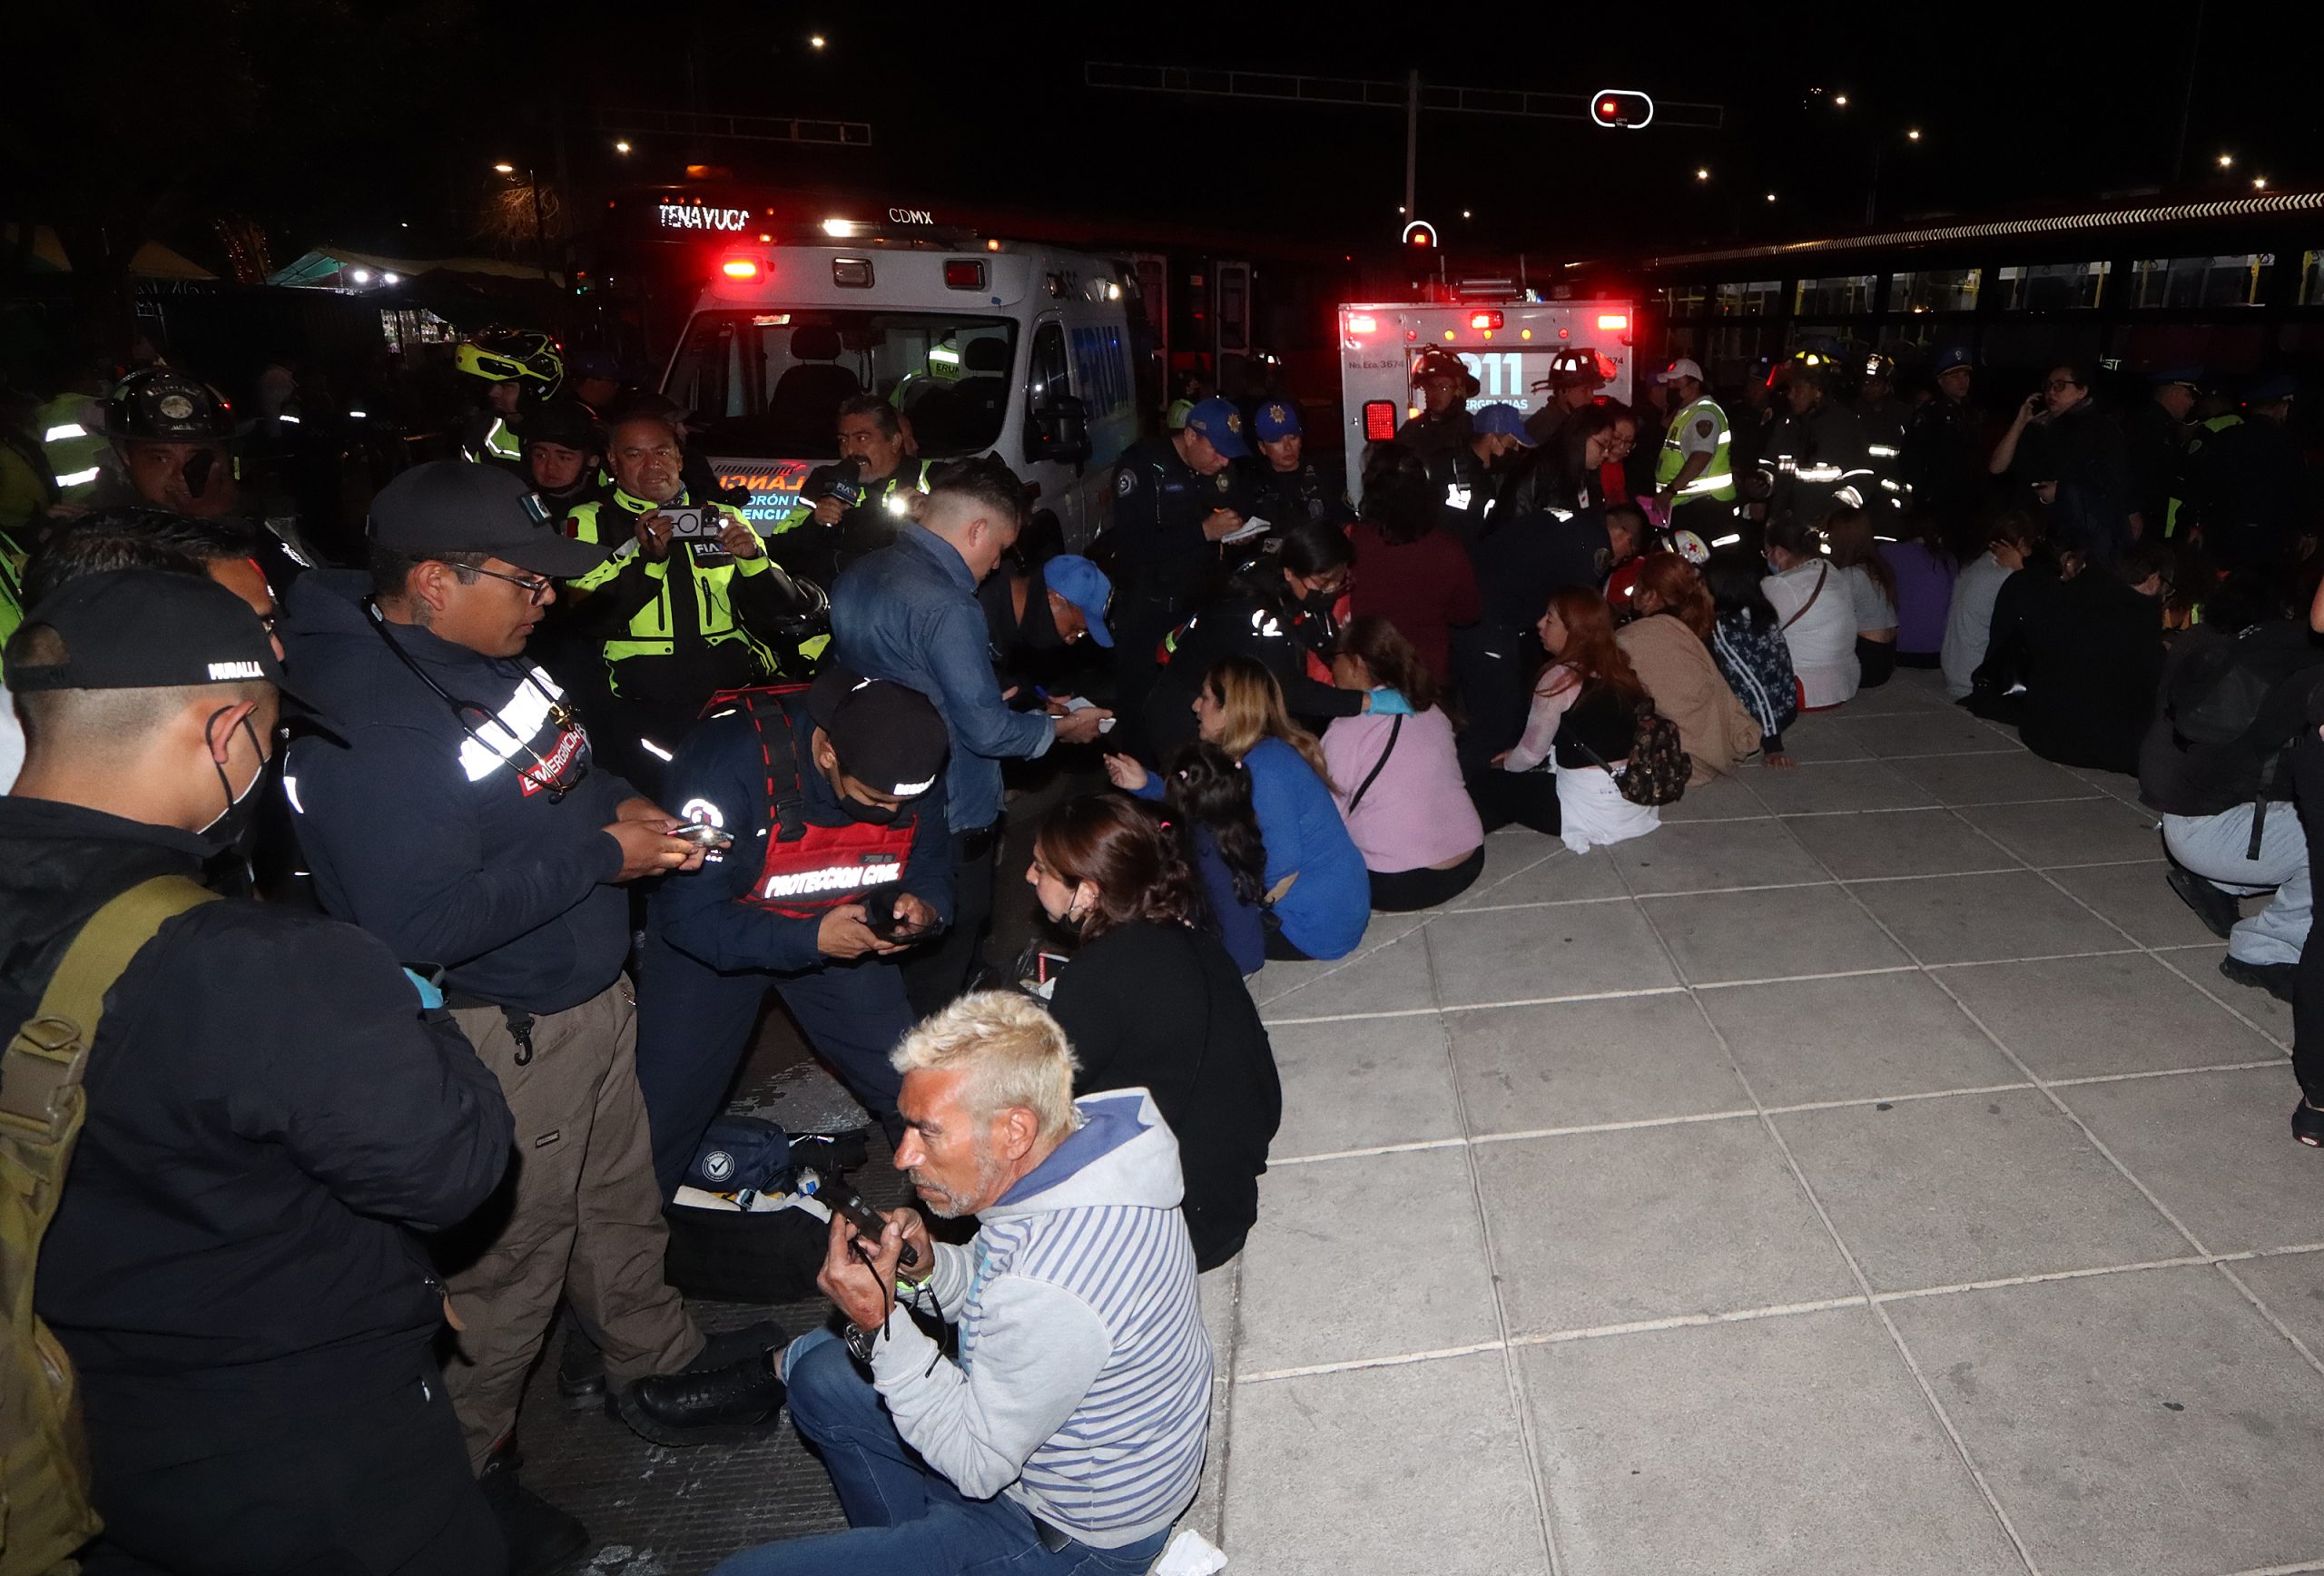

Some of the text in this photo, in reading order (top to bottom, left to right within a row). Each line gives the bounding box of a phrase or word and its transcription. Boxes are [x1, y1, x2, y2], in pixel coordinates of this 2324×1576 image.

[889, 207, 934, 225] CDMX
[1380, 360, 1405, 369] 3674
[746, 493, 790, 507] DRÓN
[742, 508, 792, 521] ENCIA
[764, 866, 864, 900] PROTECCION
